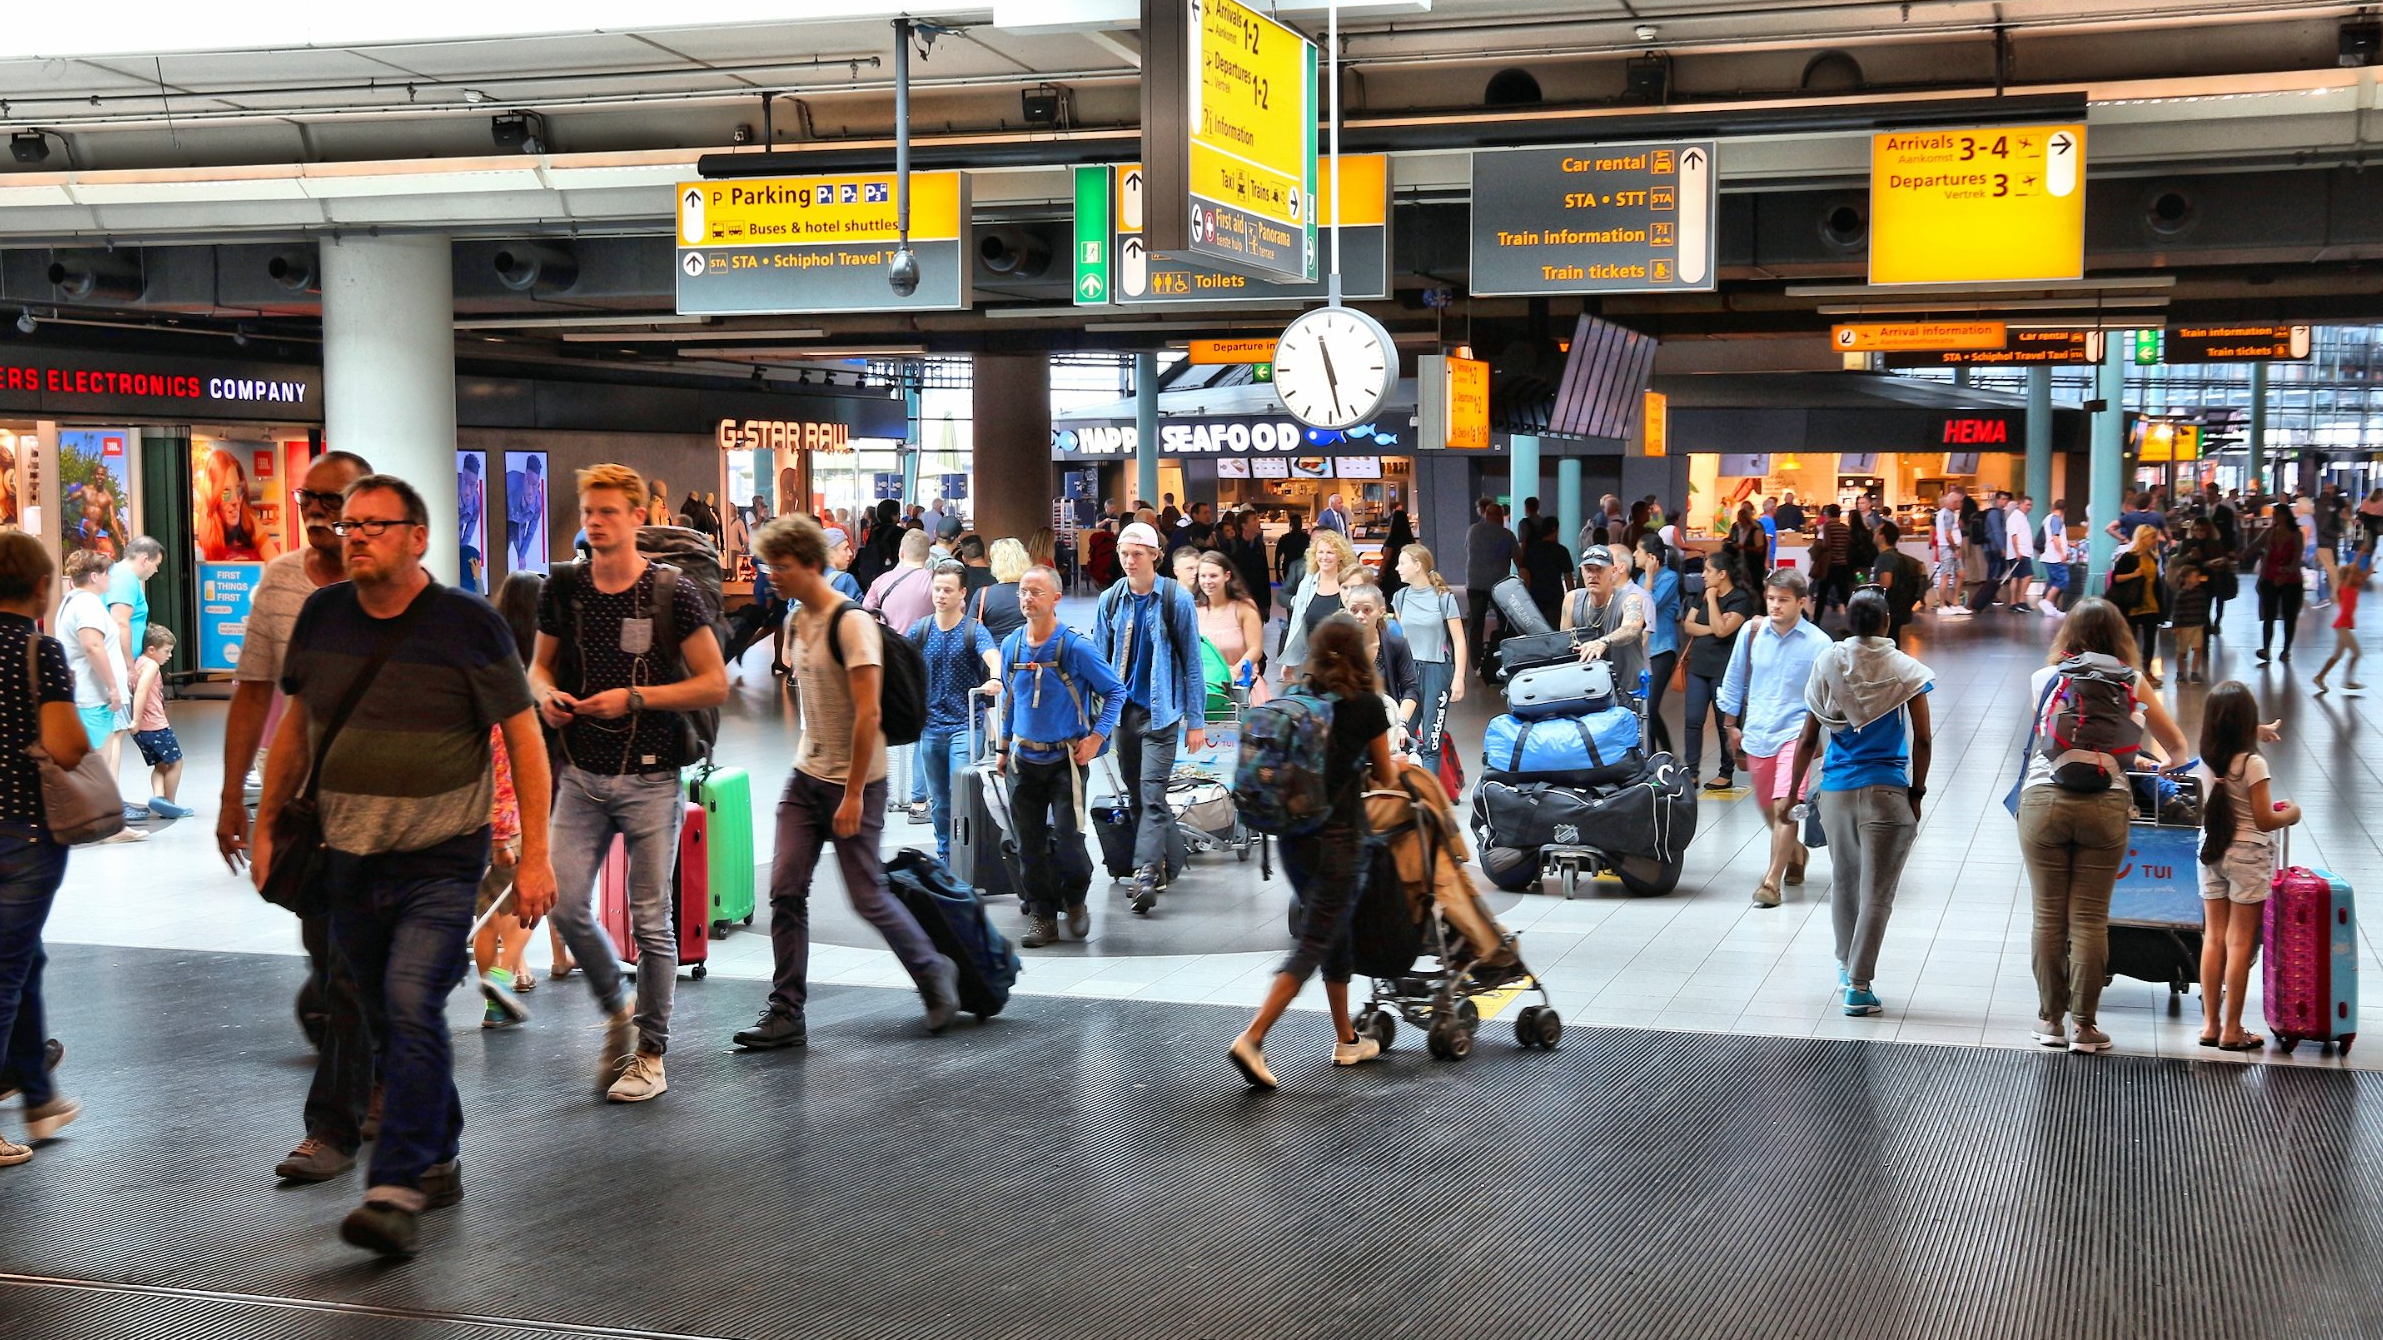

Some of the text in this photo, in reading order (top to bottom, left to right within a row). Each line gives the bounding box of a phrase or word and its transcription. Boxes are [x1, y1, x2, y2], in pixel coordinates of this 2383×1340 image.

[1216, 1, 1259, 55] Arrivals 1-2
[1215, 52, 1268, 110] Departures 1-2
[1215, 114, 1254, 146] Information
[1887, 135, 2009, 161] Arrivals 3-4
[1562, 154, 1646, 172] Car rental
[1898, 154, 1953, 164] Aankomst
[1221, 169, 1270, 201] Taxi Trains
[1890, 173, 2008, 197] Departures 3
[732, 185, 811, 208] Parking
[1565, 192, 1672, 208] STA STT STA
[1944, 190, 1986, 199] Vertrek
[750, 217, 899, 235] Buses & hotel shuttles
[1216, 208, 1244, 234] First aid
[1258, 221, 1291, 247] Panorama
[1498, 231, 1539, 246] Train
[1544, 228, 1646, 245] information
[732, 256, 758, 268] STA
[774, 253, 834, 270] Schiphol
[838, 251, 881, 265] Travel
[1195, 274, 1245, 288] Toilets
[1542, 264, 1645, 280] Train tickets
[1880, 325, 1992, 337] Arrival information
[2180, 326, 2272, 337] Train information
[1213, 342, 1263, 353] Departure
[1943, 353, 1961, 362] STA
[1972, 351, 2012, 362] Schiphol
[2015, 351, 2044, 360] Travel
[2047, 350, 2068, 360] Taxi
[2207, 346, 2272, 357] Train tickets
[47, 369, 201, 398] ELECTRONICS
[209, 377, 307, 403] COMPANY
[720, 418, 850, 450] G-STAR RAW
[1078, 422, 1302, 454] HAPP SEAFOOD
[1943, 419, 2007, 444] HEMA
[217, 571, 241, 579] FIRST
[217, 582, 248, 590] THINGS
[217, 594, 241, 602] FIRST
[1431, 708, 1446, 750] adidas
[2141, 864, 2172, 879] TUI
